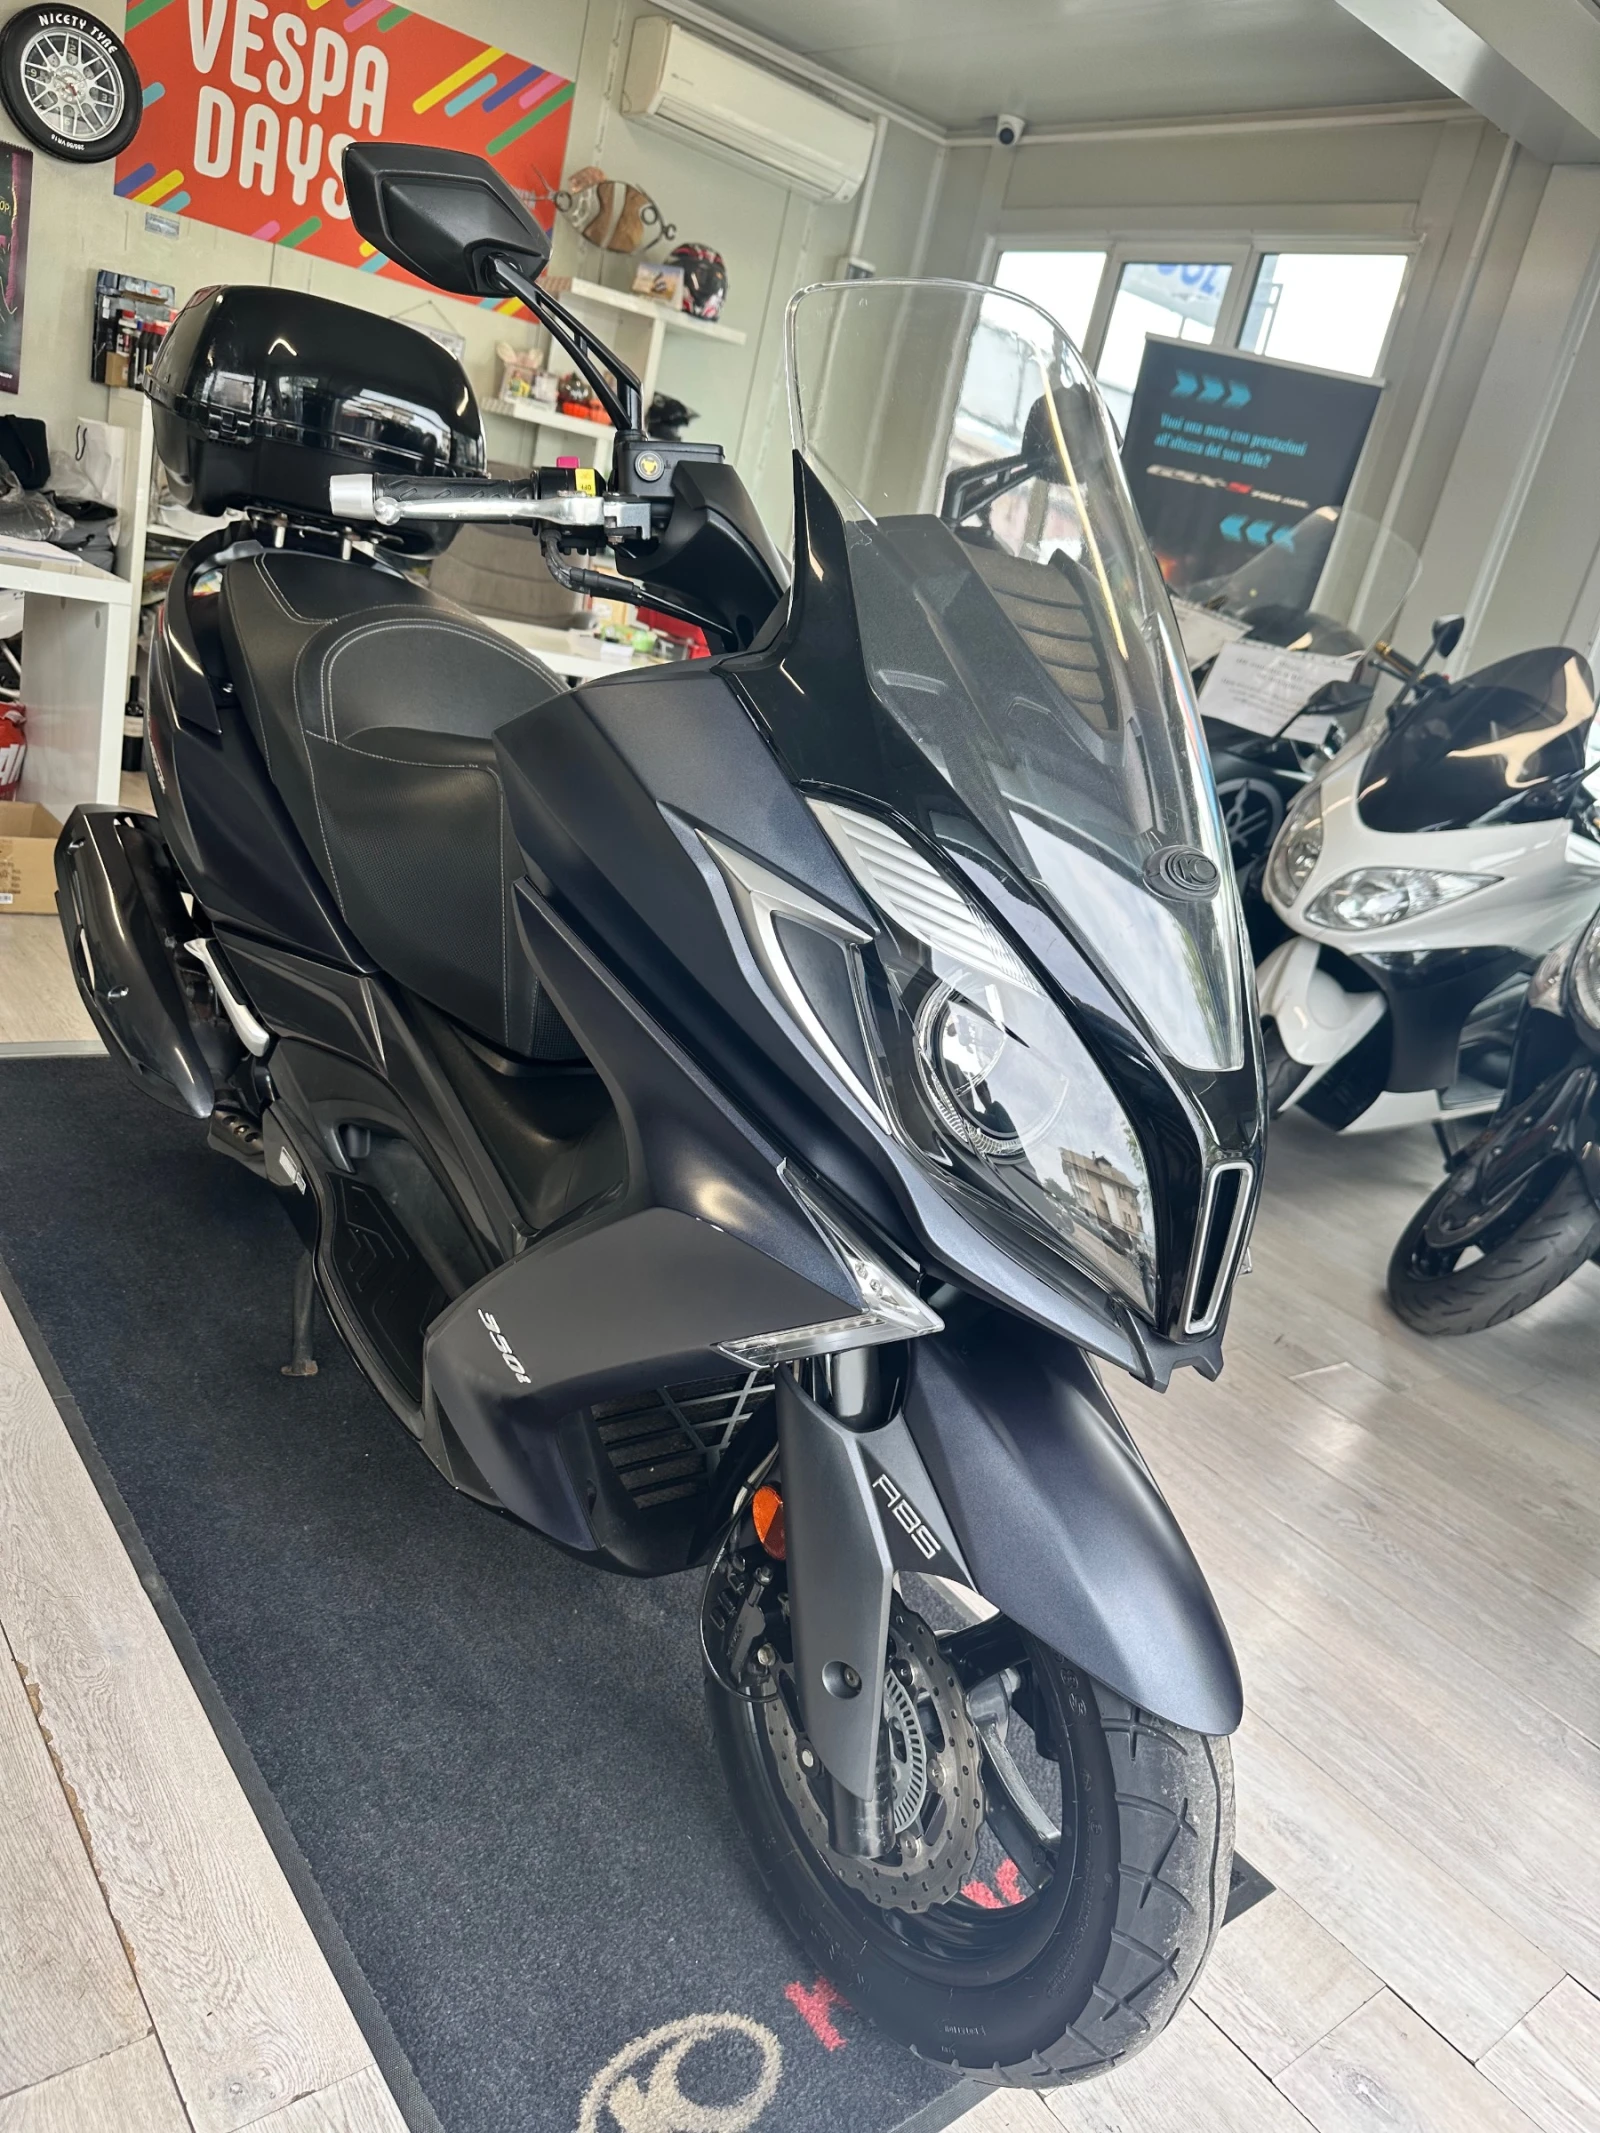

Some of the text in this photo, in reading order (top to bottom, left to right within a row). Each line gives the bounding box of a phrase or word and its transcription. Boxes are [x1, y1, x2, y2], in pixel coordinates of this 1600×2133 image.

[38, 13, 118, 54] NICETY TYRE
[187, 0, 389, 137] VESPA
[193, 85, 359, 220] DAYS
[1161, 413, 1308, 456] Vuoi una moto con prestazioni
[1205, 441, 1222, 457] del
[1222, 448, 1241, 462] suo
[1241, 451, 1273, 468] stile?
[872, 1473, 942, 1560] ABS
